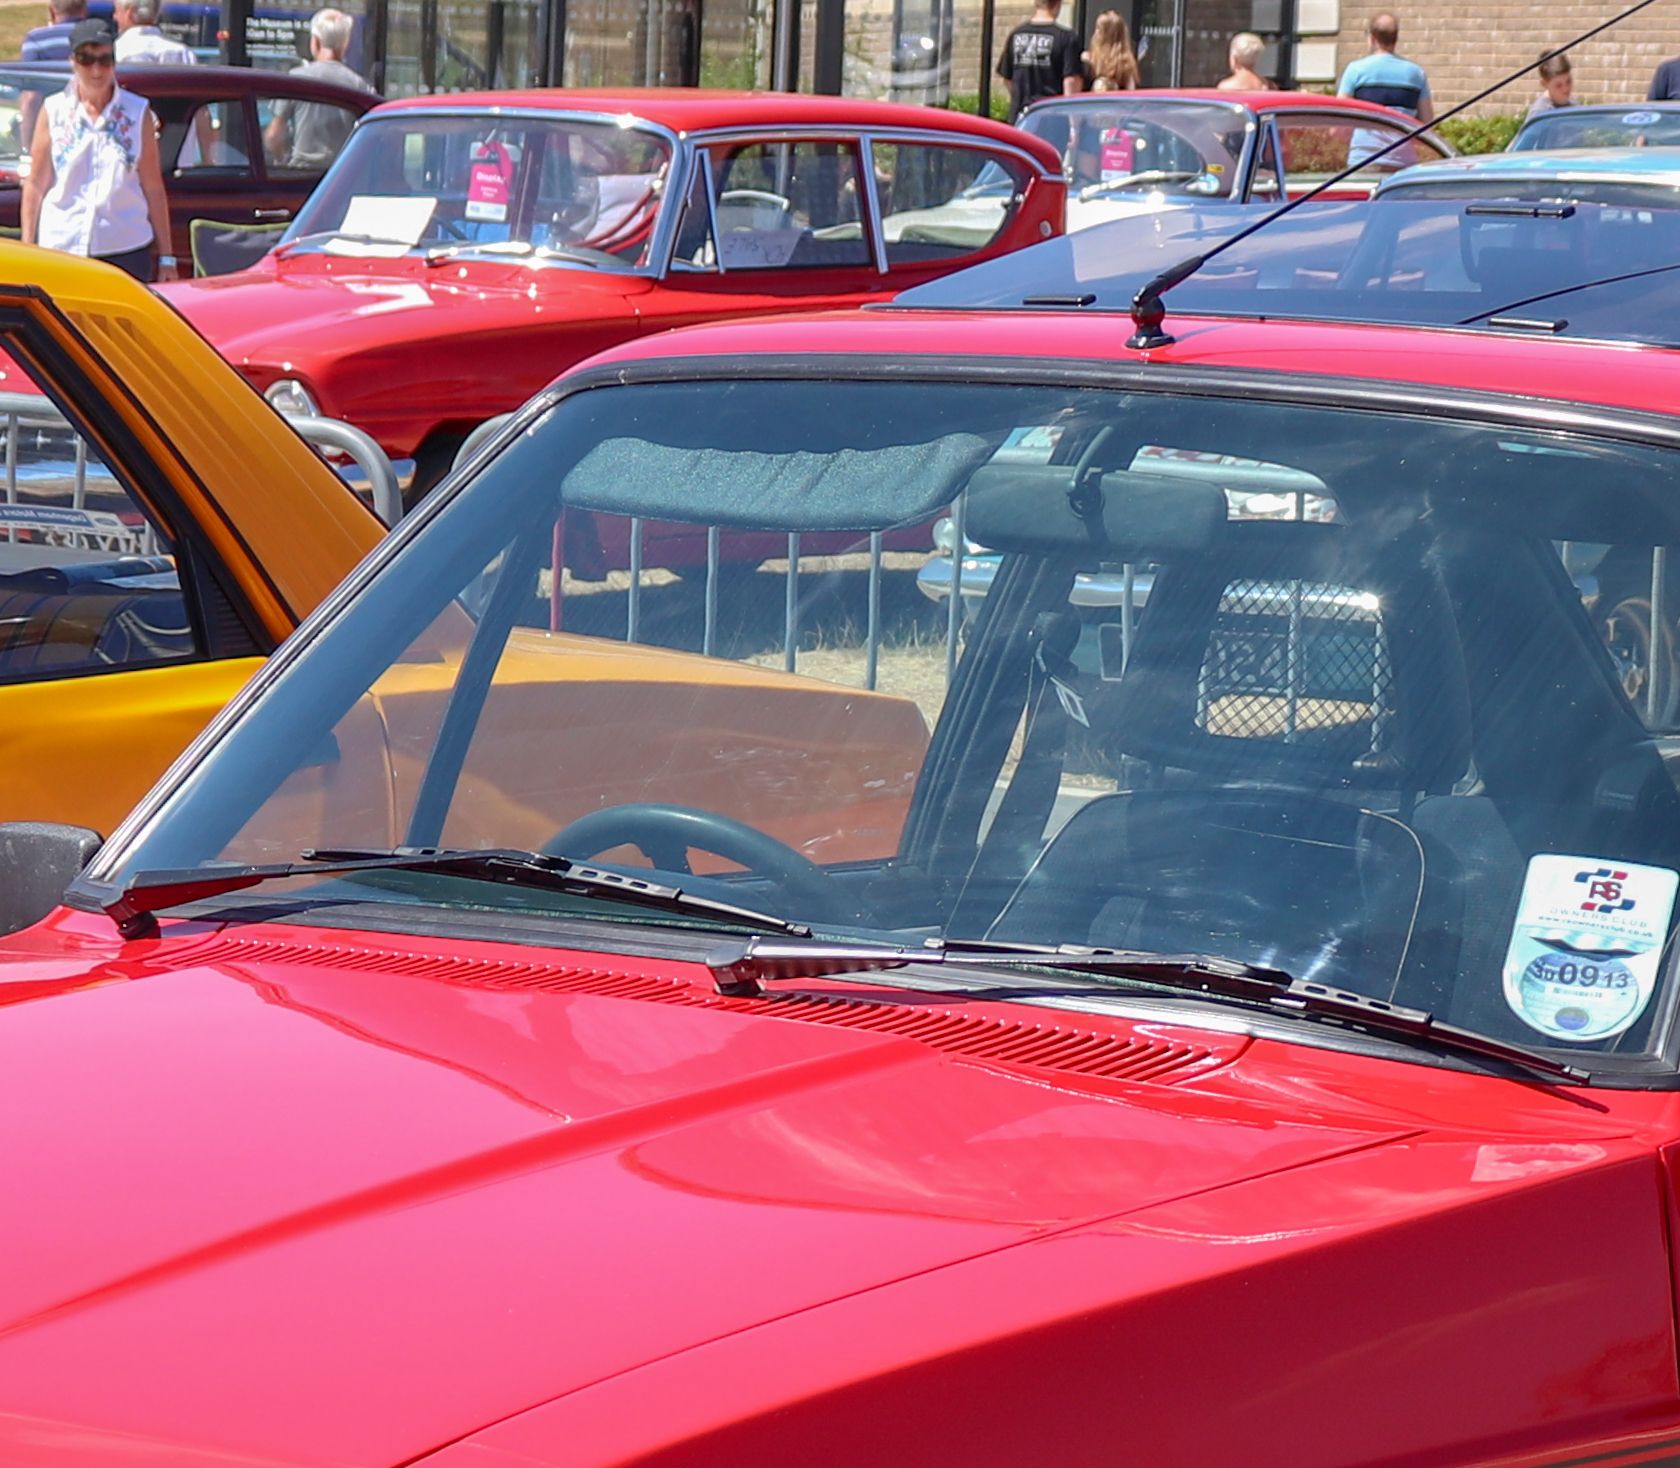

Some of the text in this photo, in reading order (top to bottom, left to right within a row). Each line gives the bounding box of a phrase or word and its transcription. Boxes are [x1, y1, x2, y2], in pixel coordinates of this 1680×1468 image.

[1588, 881, 1624, 902] RS
[1550, 907, 1648, 928] OWNERS CLUB
[1559, 962, 1600, 987] 09
[1605, 972, 1629, 988] 13
